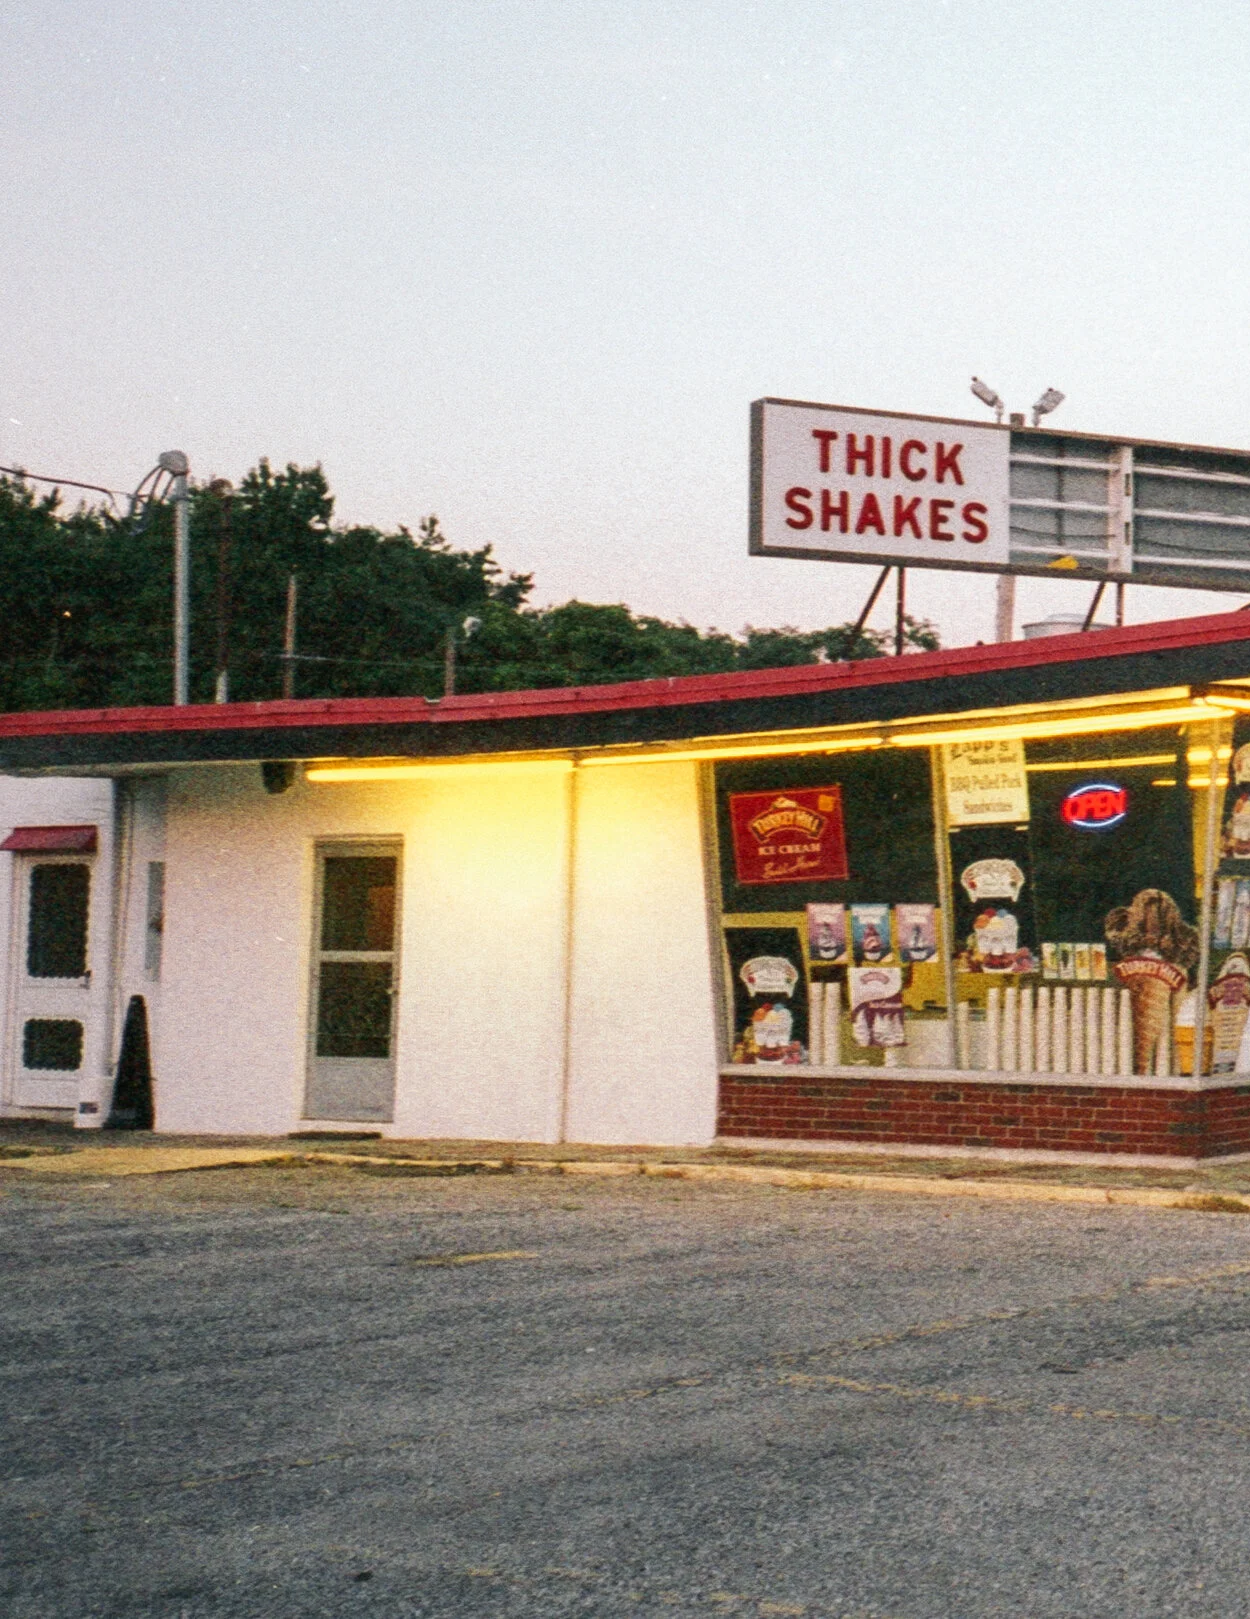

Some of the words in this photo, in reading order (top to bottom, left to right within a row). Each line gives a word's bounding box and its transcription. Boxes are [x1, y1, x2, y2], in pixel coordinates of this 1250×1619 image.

[811, 429, 964, 485] THICK
[784, 487, 989, 544] SHAKES
[1063, 790, 1127, 822] OPEN
[758, 846, 776, 856] ICE
[778, 843, 821, 854] CREAM
